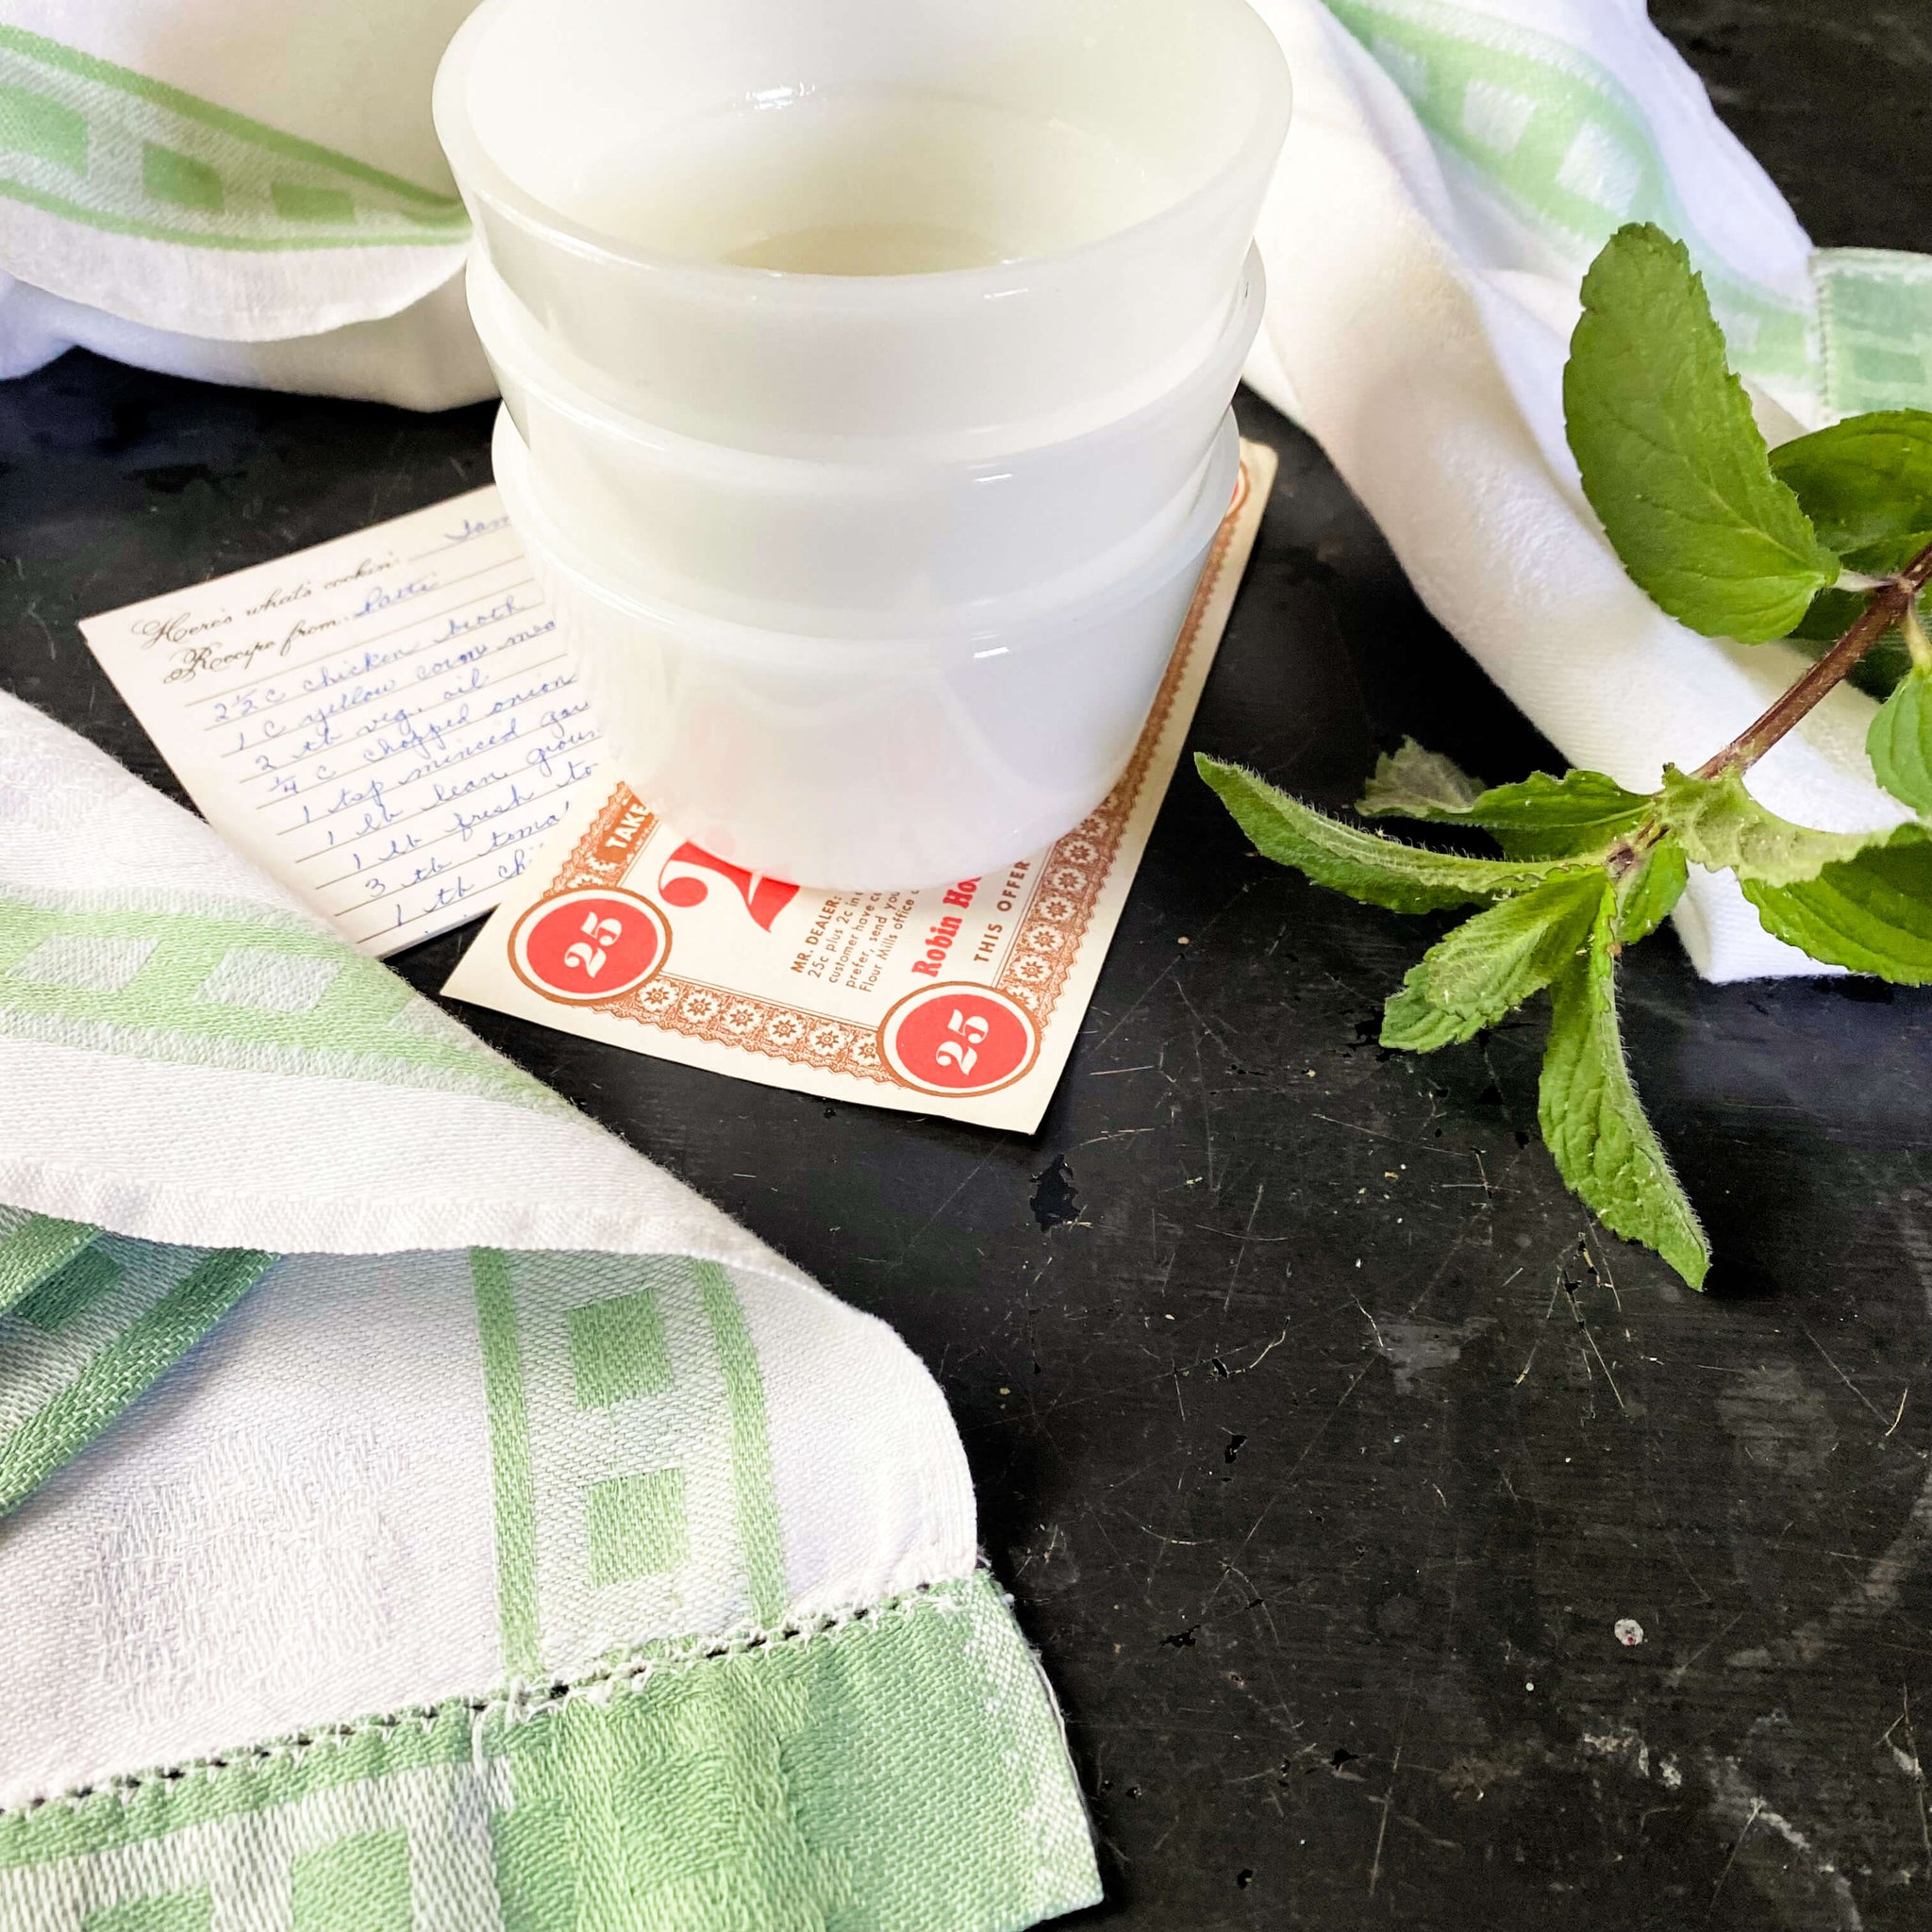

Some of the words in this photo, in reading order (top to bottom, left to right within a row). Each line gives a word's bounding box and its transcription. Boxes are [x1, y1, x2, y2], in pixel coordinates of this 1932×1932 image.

[162, 640, 275, 685] Recipe
[303, 645, 421, 692] chicken
[363, 702, 470, 764] chopped
[483, 672, 577, 720] onion
[605, 802, 651, 849] TAKE
[562, 910, 624, 979] 25
[790, 946, 815, 974] MR.
[804, 894, 843, 947] DEALER:
[824, 928, 845, 954] plus
[845, 896, 861, 908] in
[827, 933, 860, 986] customer
[852, 904, 875, 933] have
[868, 915, 888, 942] send
[973, 922, 1004, 963] THIS
[996, 859, 1031, 912] OFFER
[858, 963, 884, 993] Flour
[878, 932, 899, 961] Mills
[891, 898, 916, 930] office
[910, 915, 963, 978] Robin
[935, 1008, 990, 1076] 25
